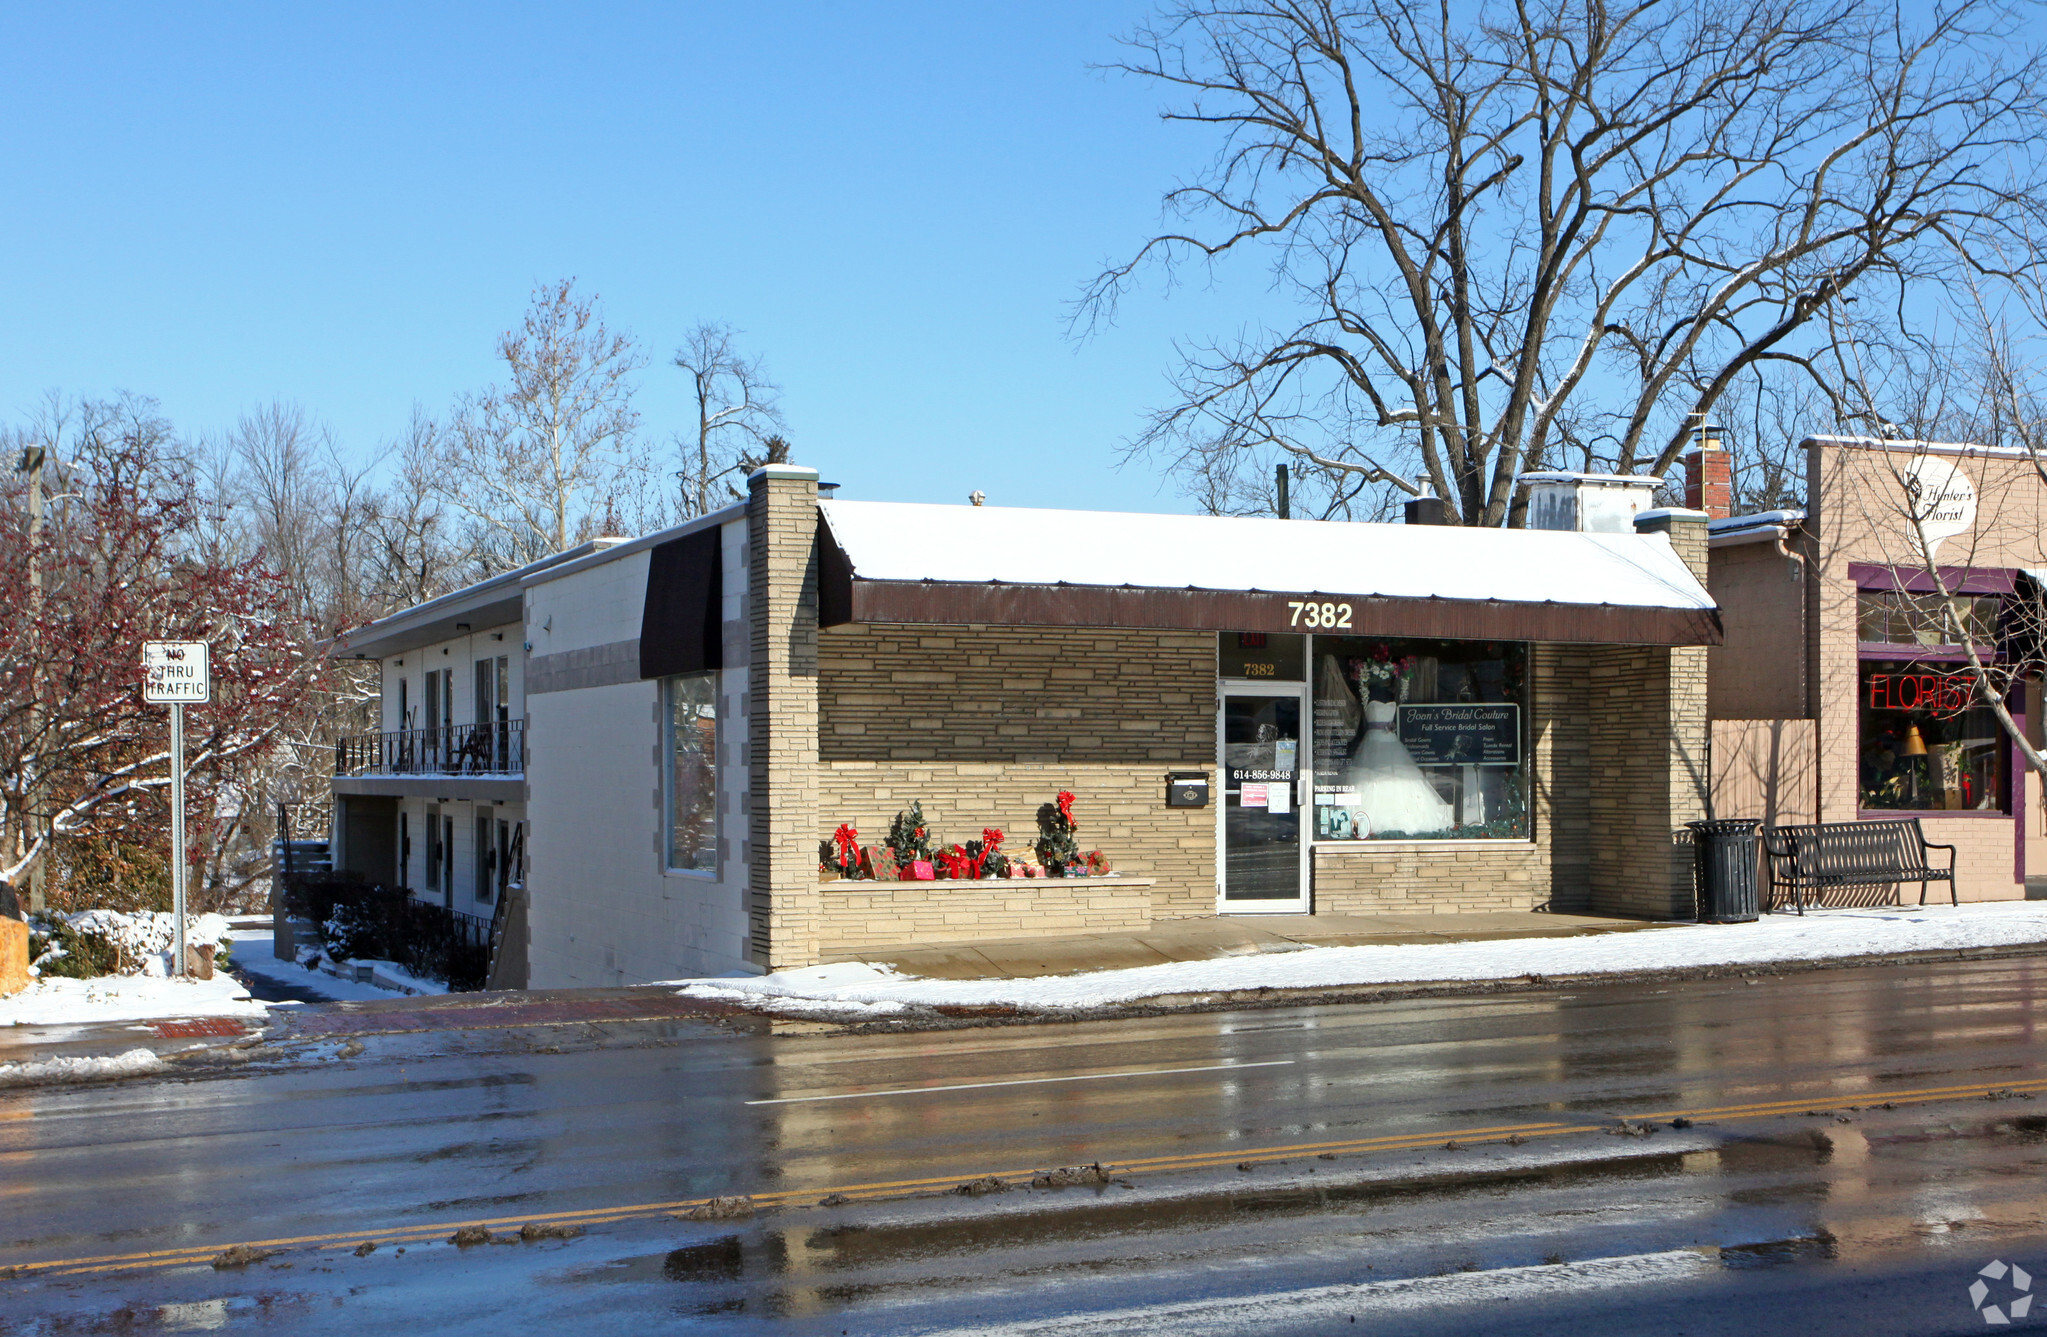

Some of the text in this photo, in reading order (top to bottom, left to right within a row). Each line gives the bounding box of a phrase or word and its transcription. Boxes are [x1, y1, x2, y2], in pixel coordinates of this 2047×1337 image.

[1923, 484, 1972, 501] Hunter's
[1922, 503, 1964, 521] Florist
[1288, 601, 1353, 628] 7382
[166, 648, 185, 661] NO
[158, 666, 194, 678] THRU
[1244, 663, 1275, 676] 7382
[149, 683, 204, 695] TRAFFIC
[1871, 675, 1977, 710] FLORIST
[1407, 708, 1509, 723] Joan's Bridal Couture
[1421, 723, 1496, 731] Full Service Bridal Salon
[1233, 769, 1291, 780] 614-856-9848
